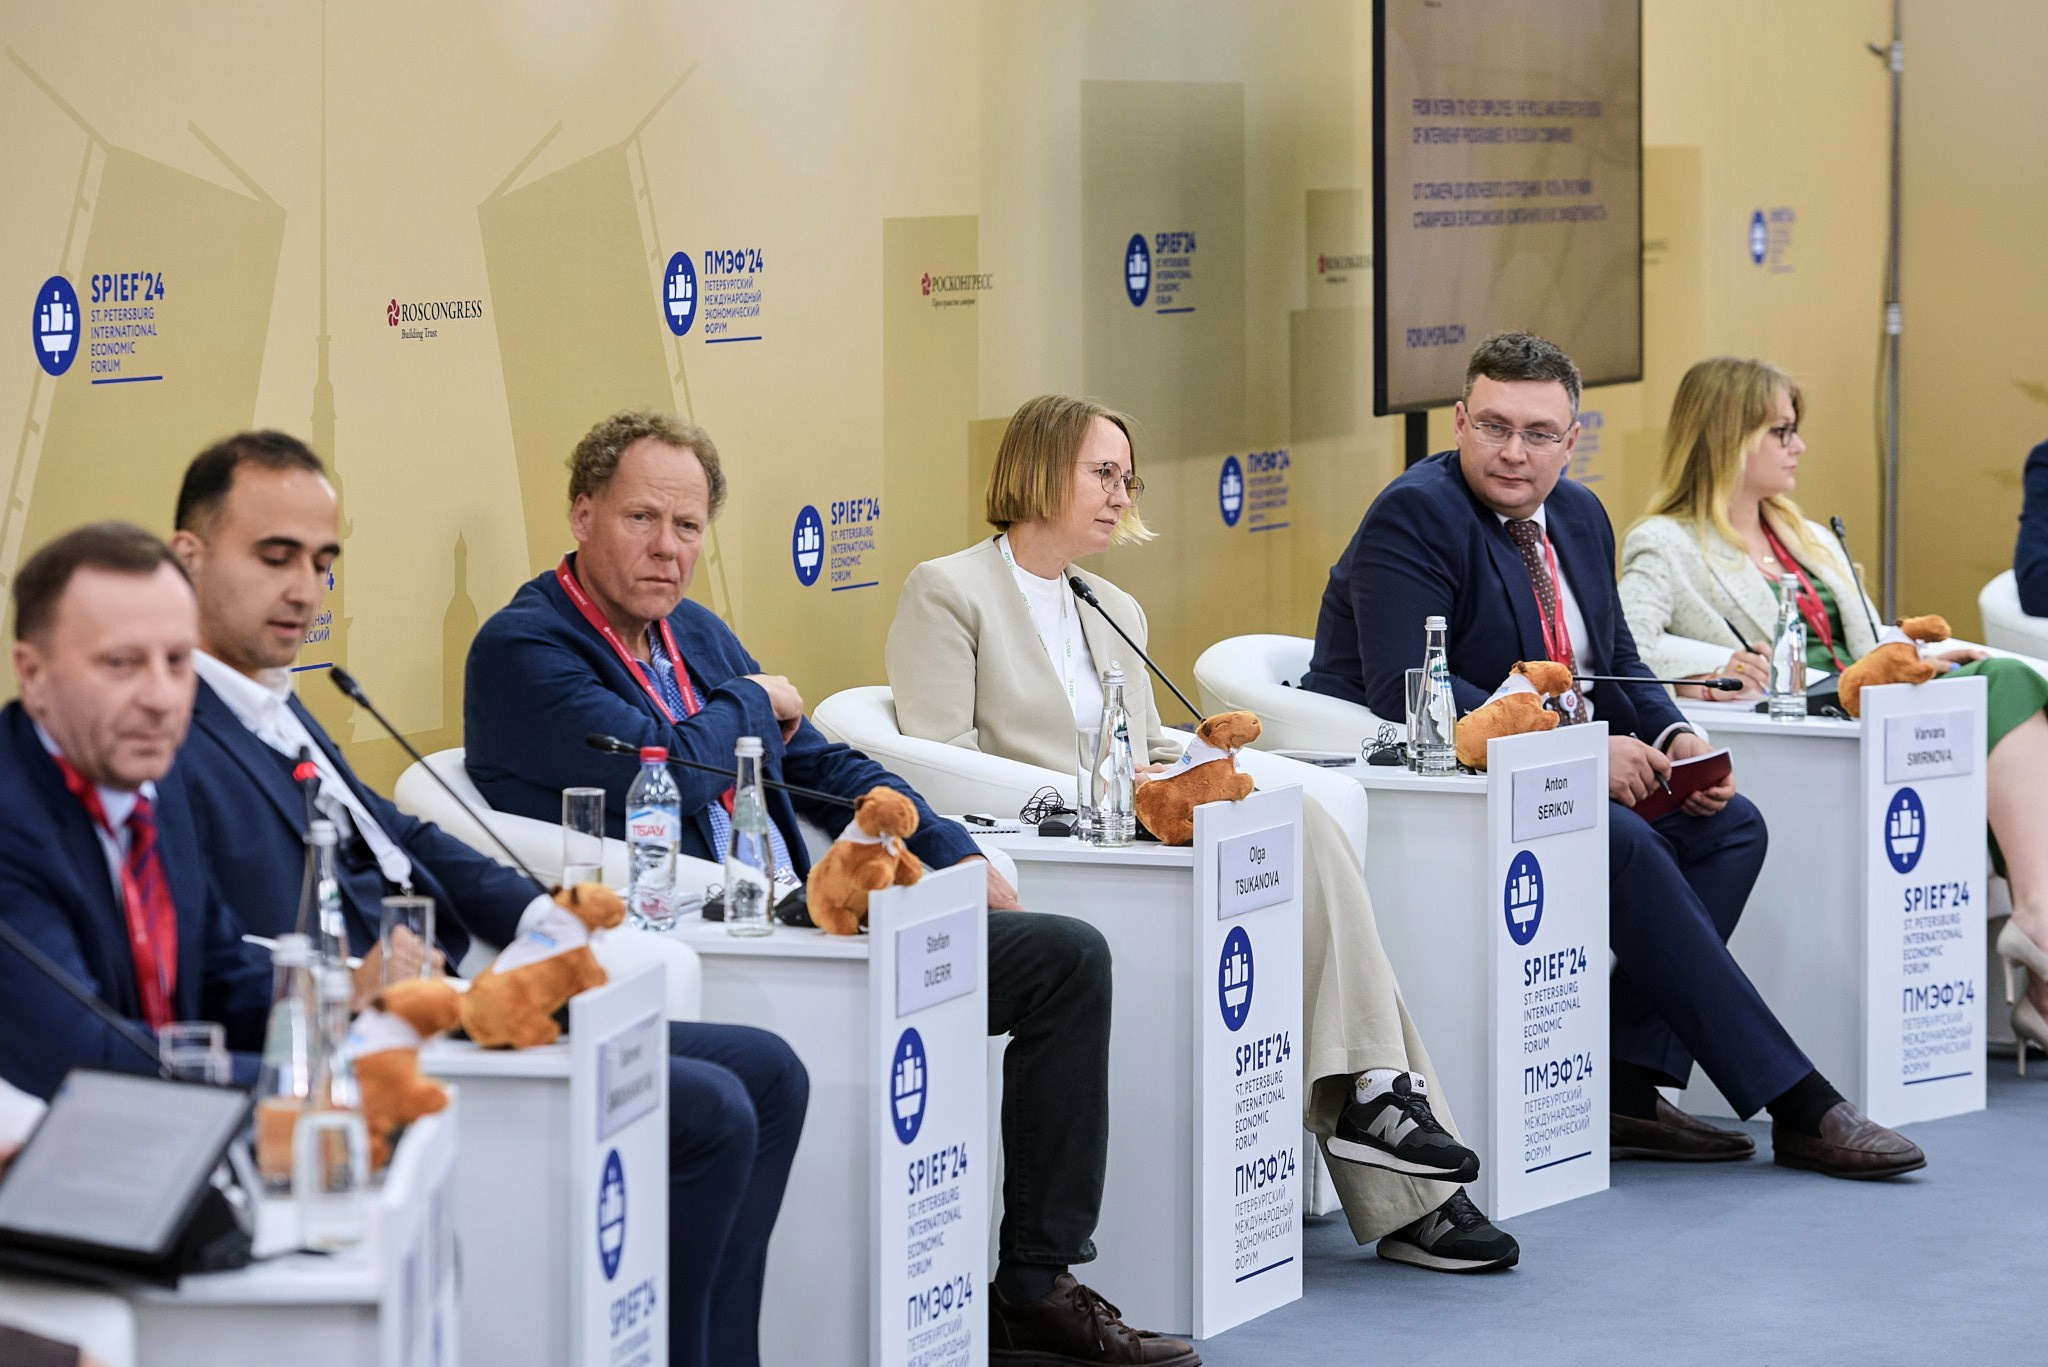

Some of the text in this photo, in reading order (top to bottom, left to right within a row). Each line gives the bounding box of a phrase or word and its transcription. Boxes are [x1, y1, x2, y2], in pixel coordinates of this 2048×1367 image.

[705, 248, 763, 275] ПМЭФ'24
[91, 271, 165, 303] SPIEF'24
[705, 276, 754, 291] ПЕТЕРБУРГСКИЙ
[705, 290, 762, 306] МЕЖДУНАРОДНЫЙ
[91, 307, 154, 322] ST. PETERSBURG
[401, 300, 483, 322] ROSCONGRESS
[705, 304, 760, 320] ЭКОНОМИЧЕСКИЙ
[91, 324, 158, 339] INTERNATIONAL
[401, 328, 423, 341] Building
[705, 322, 727, 334] ФОРУМ
[91, 341, 136, 356] ECONOMIC
[91, 359, 121, 373] FORUM
[831, 497, 880, 525] SPIEF'24
[839, 526, 873, 540] PETERSBURG
[831, 540, 875, 555] INTERNATIONAL
[831, 555, 861, 569] ECONOMIC
[831, 570, 851, 582] FORUM
[1545, 776, 1568, 792] Anton
[1538, 800, 1574, 820] SERIKOV
[1249, 846, 1266, 865] Olga
[1235, 870, 1280, 896] TSUKANOVA
[1904, 881, 1969, 912] SPIEF'24
[927, 932, 950, 954] Stefan
[924, 963, 952, 988] DUERR
[1524, 945, 1587, 987] SPIEF'24
[1524, 981, 1578, 1006] ST. PETERSBURG
[1904, 979, 1974, 1012] ПМЭФ'24
[1524, 997, 1581, 1022] INTERNATIONAL
[1524, 1017, 1562, 1038] ECONOMIC
[1236, 1030, 1291, 1077] SPIEF'24
[1524, 1037, 1550, 1055] FORUM
[1236, 1070, 1283, 1097] ST. PETERSBURG
[1525, 1051, 1593, 1095] ПМЭФ'24
[1236, 1087, 1285, 1116] INTERNATIONAL
[1524, 1085, 1582, 1115] ПЕТЕРБУРГСКИЙ
[1236, 1110, 1269, 1133] ECONOMIC
[1524, 1098, 1591, 1131] МЕЖДУНАРОДНЫЙ
[1236, 1132, 1258, 1152] FORUM
[1524, 1115, 1590, 1147] ЭКОНОМИЧЕСКИЙ
[1524, 1144, 1551, 1162] ФОРУМ
[908, 1141, 967, 1196] SPIEF'24
[1235, 1147, 1295, 1197] ПМЭФ'24
[918, 1186, 959, 1214] PETERSBURG
[1235, 1184, 1285, 1217] ПЕТЕРБУРГСКИЙ
[907, 1206, 962, 1239] INTERNATIONAL
[1235, 1199, 1294, 1235] МЕЖДУНАРОДНЫЙ
[908, 1231, 944, 1260] ECONOMIC
[1235, 1217, 1292, 1254] ЭКОНОМИЧЕСКИЙ
[908, 1257, 932, 1280] FORUM
[1235, 1250, 1258, 1270] ФОРУМ
[907, 1272, 972, 1331] ПМЭФ'24
